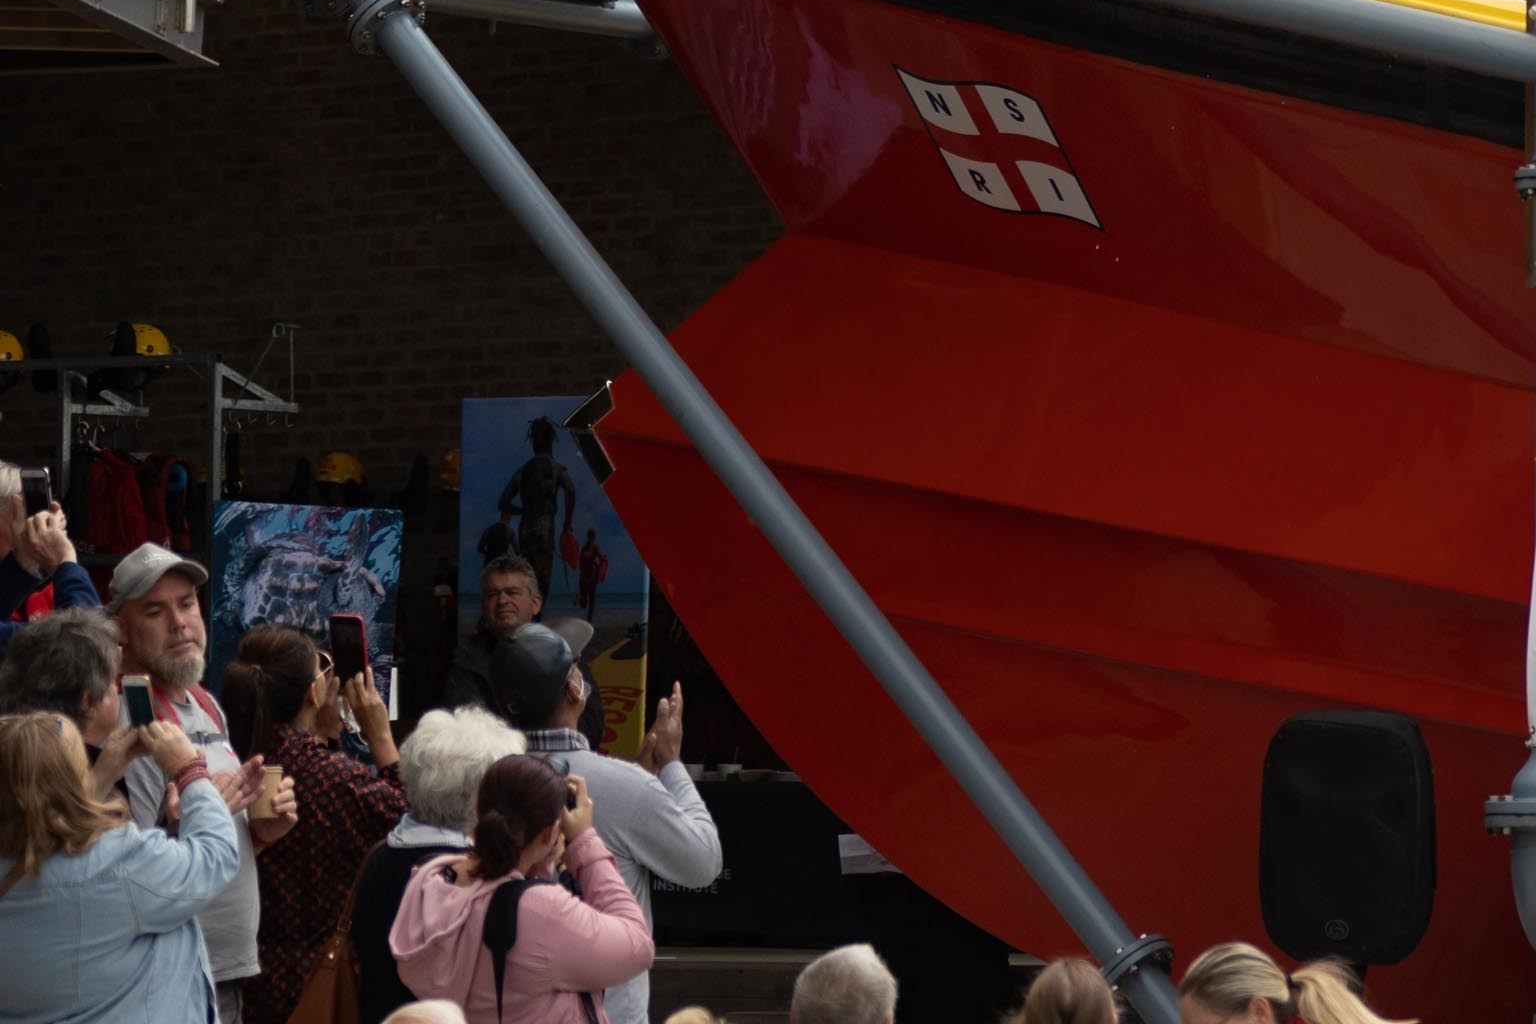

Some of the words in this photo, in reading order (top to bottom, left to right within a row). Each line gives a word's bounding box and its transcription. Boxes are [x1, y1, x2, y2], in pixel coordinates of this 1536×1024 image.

[925, 90, 952, 117] N
[1003, 98, 1025, 123] S
[967, 168, 993, 195] R
